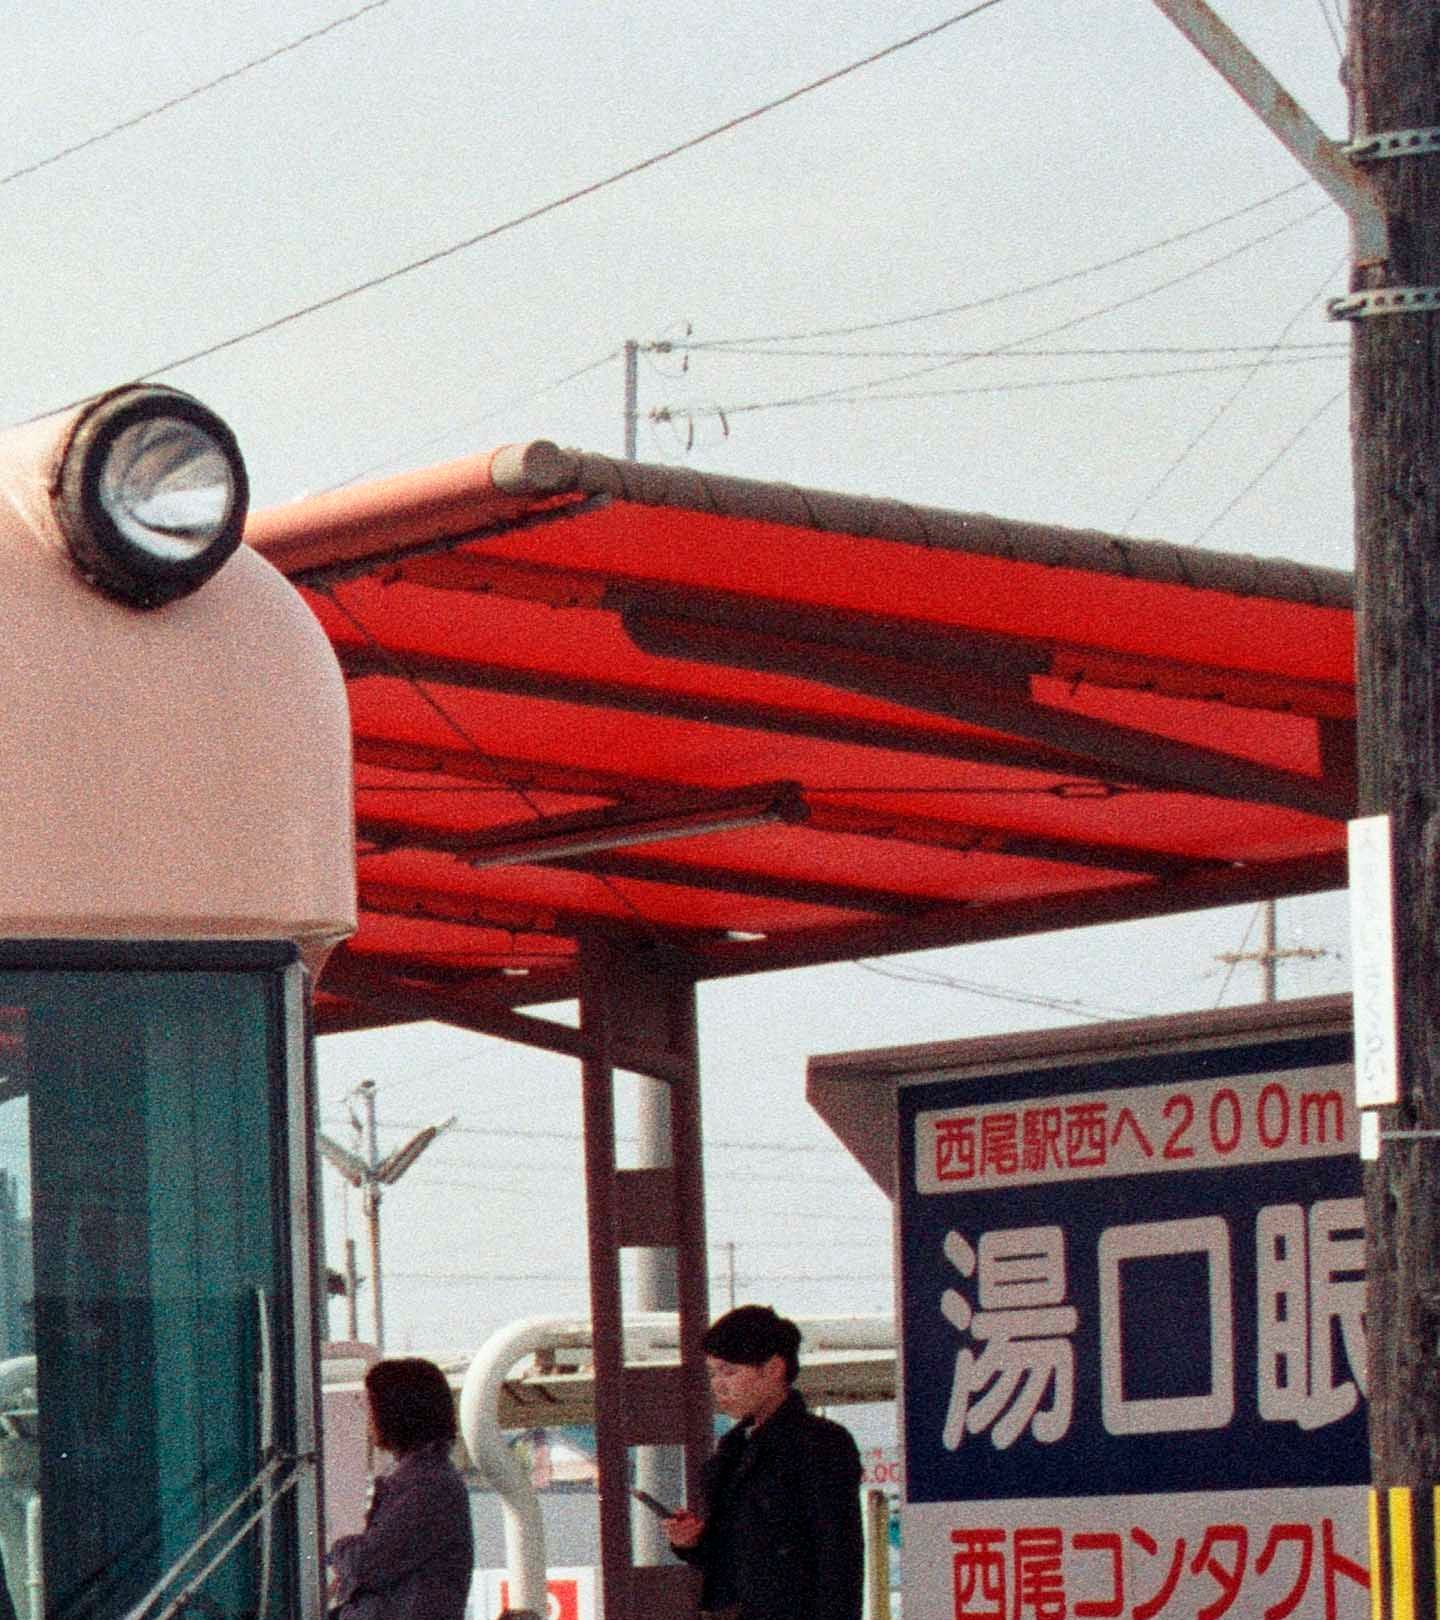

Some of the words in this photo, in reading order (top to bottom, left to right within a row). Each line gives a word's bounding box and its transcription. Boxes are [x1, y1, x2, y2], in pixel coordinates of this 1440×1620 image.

[934, 1082, 1345, 1182] 西尾駅西へ200m
[939, 1197, 1369, 1453] 湯口眼
